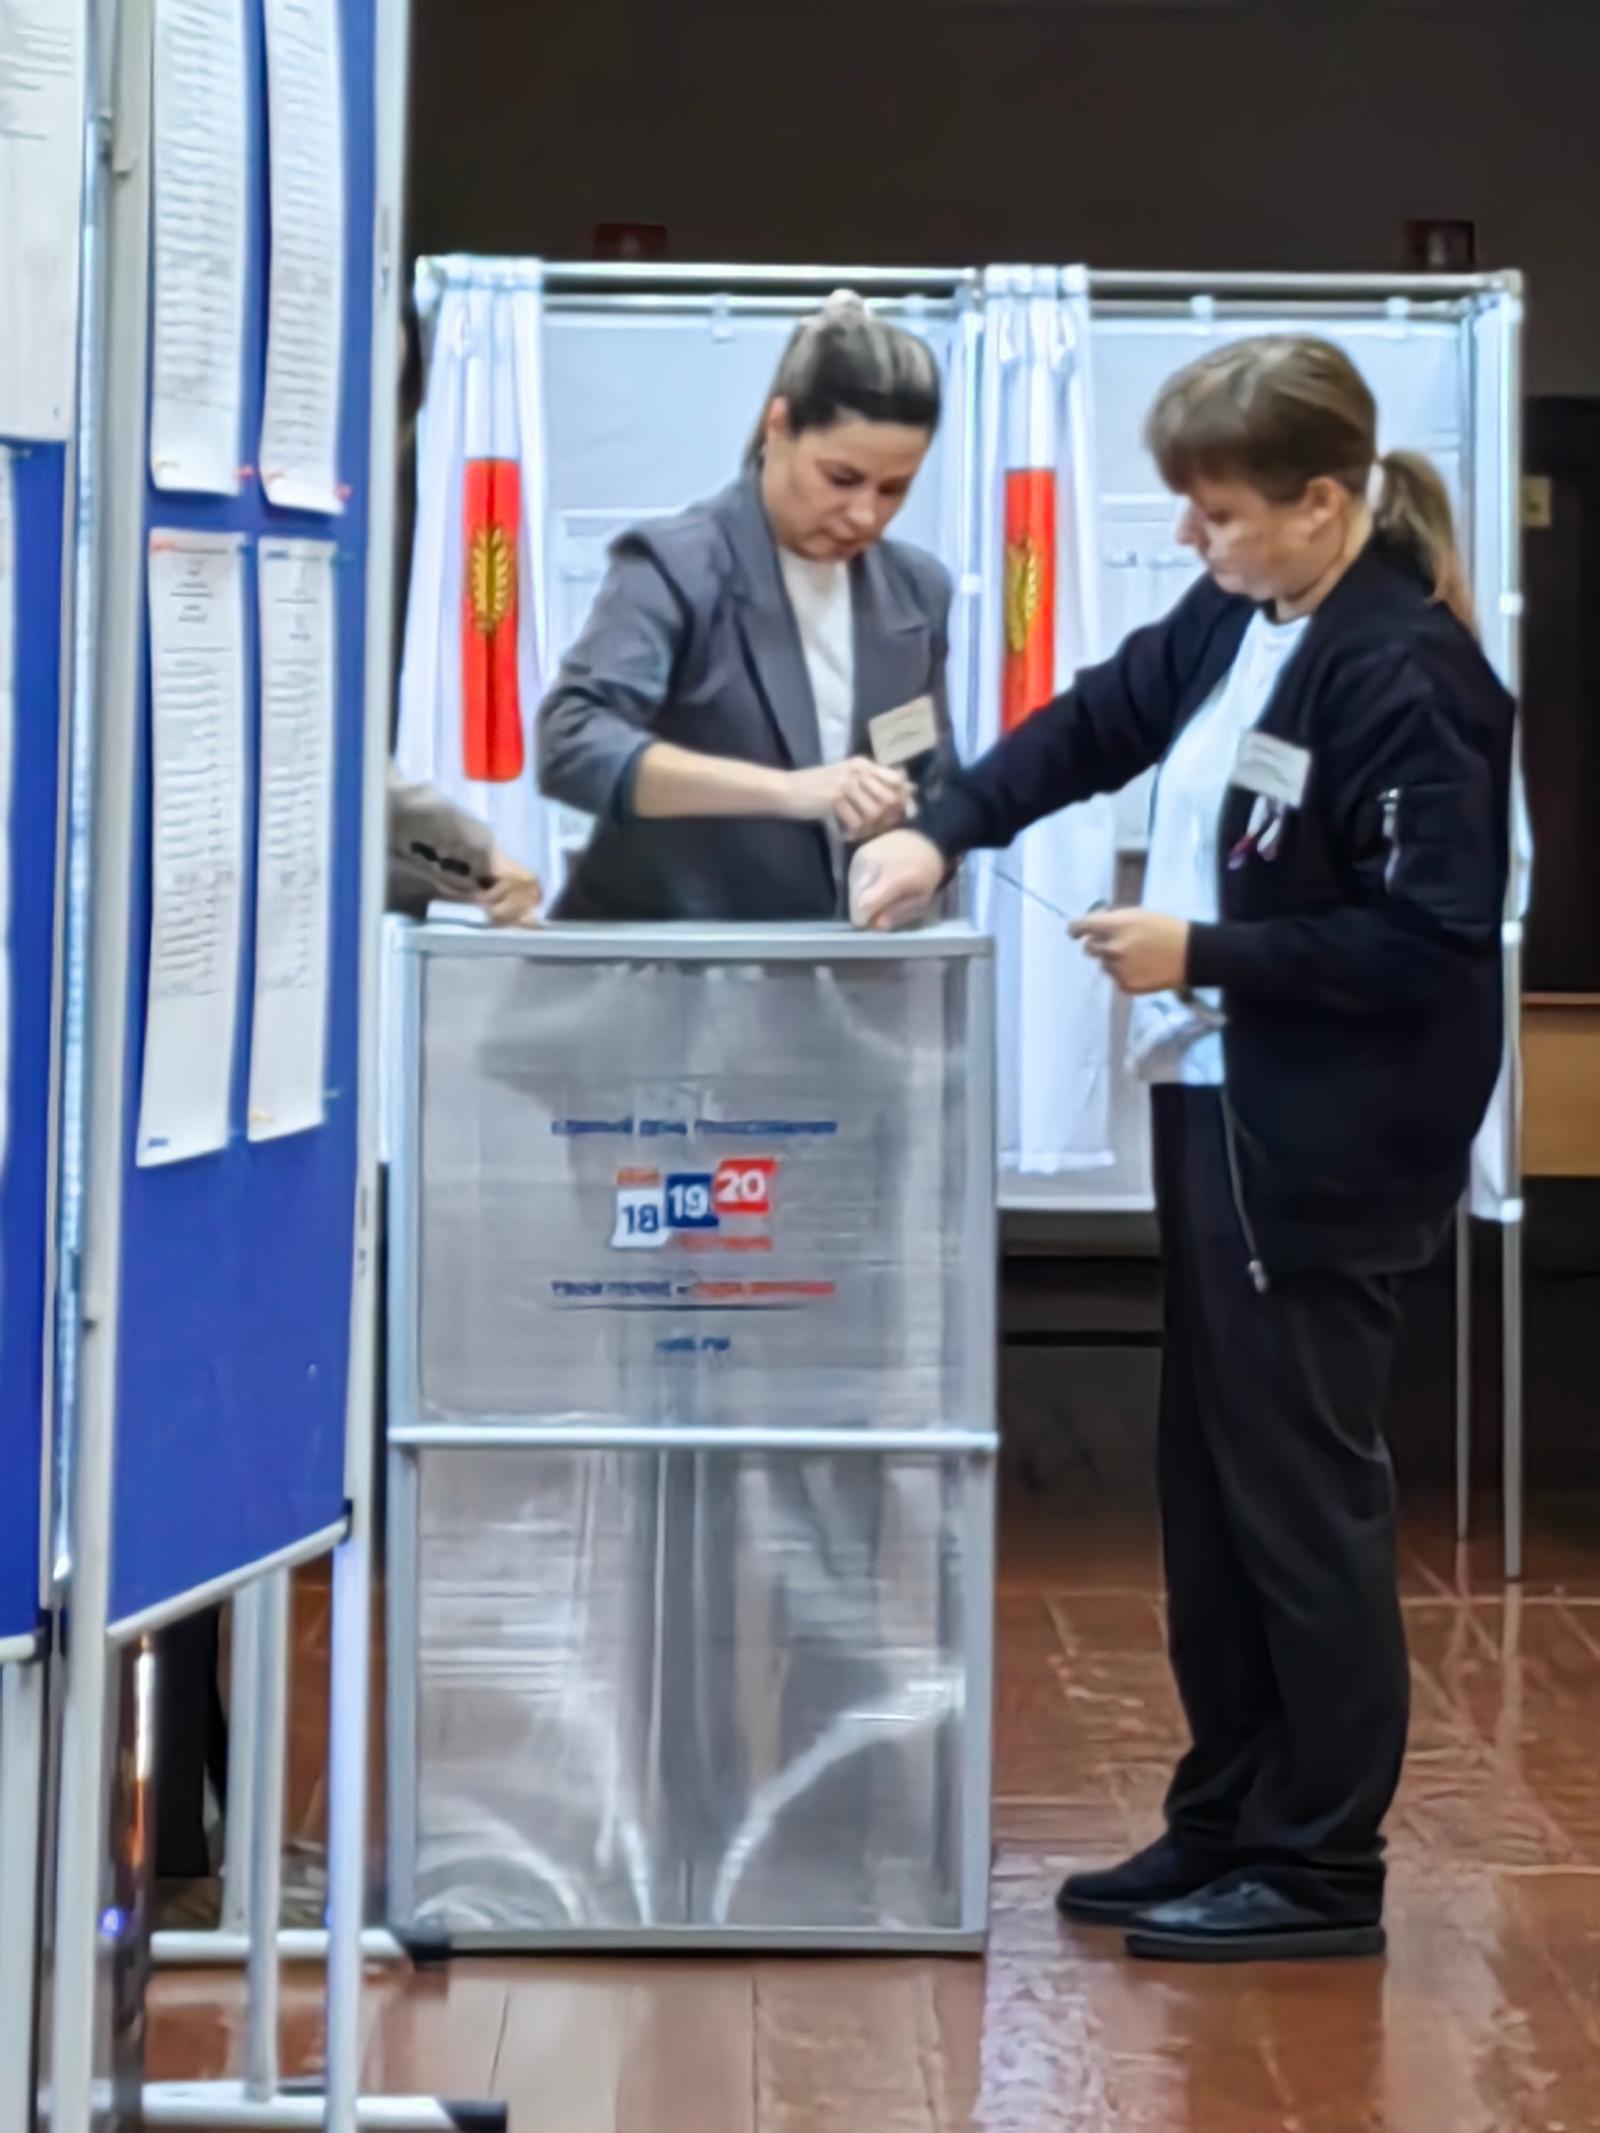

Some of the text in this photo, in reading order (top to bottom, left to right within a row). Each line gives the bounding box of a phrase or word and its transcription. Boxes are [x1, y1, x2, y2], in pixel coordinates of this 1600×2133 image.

[622, 1169, 766, 1235] 18 19 20
